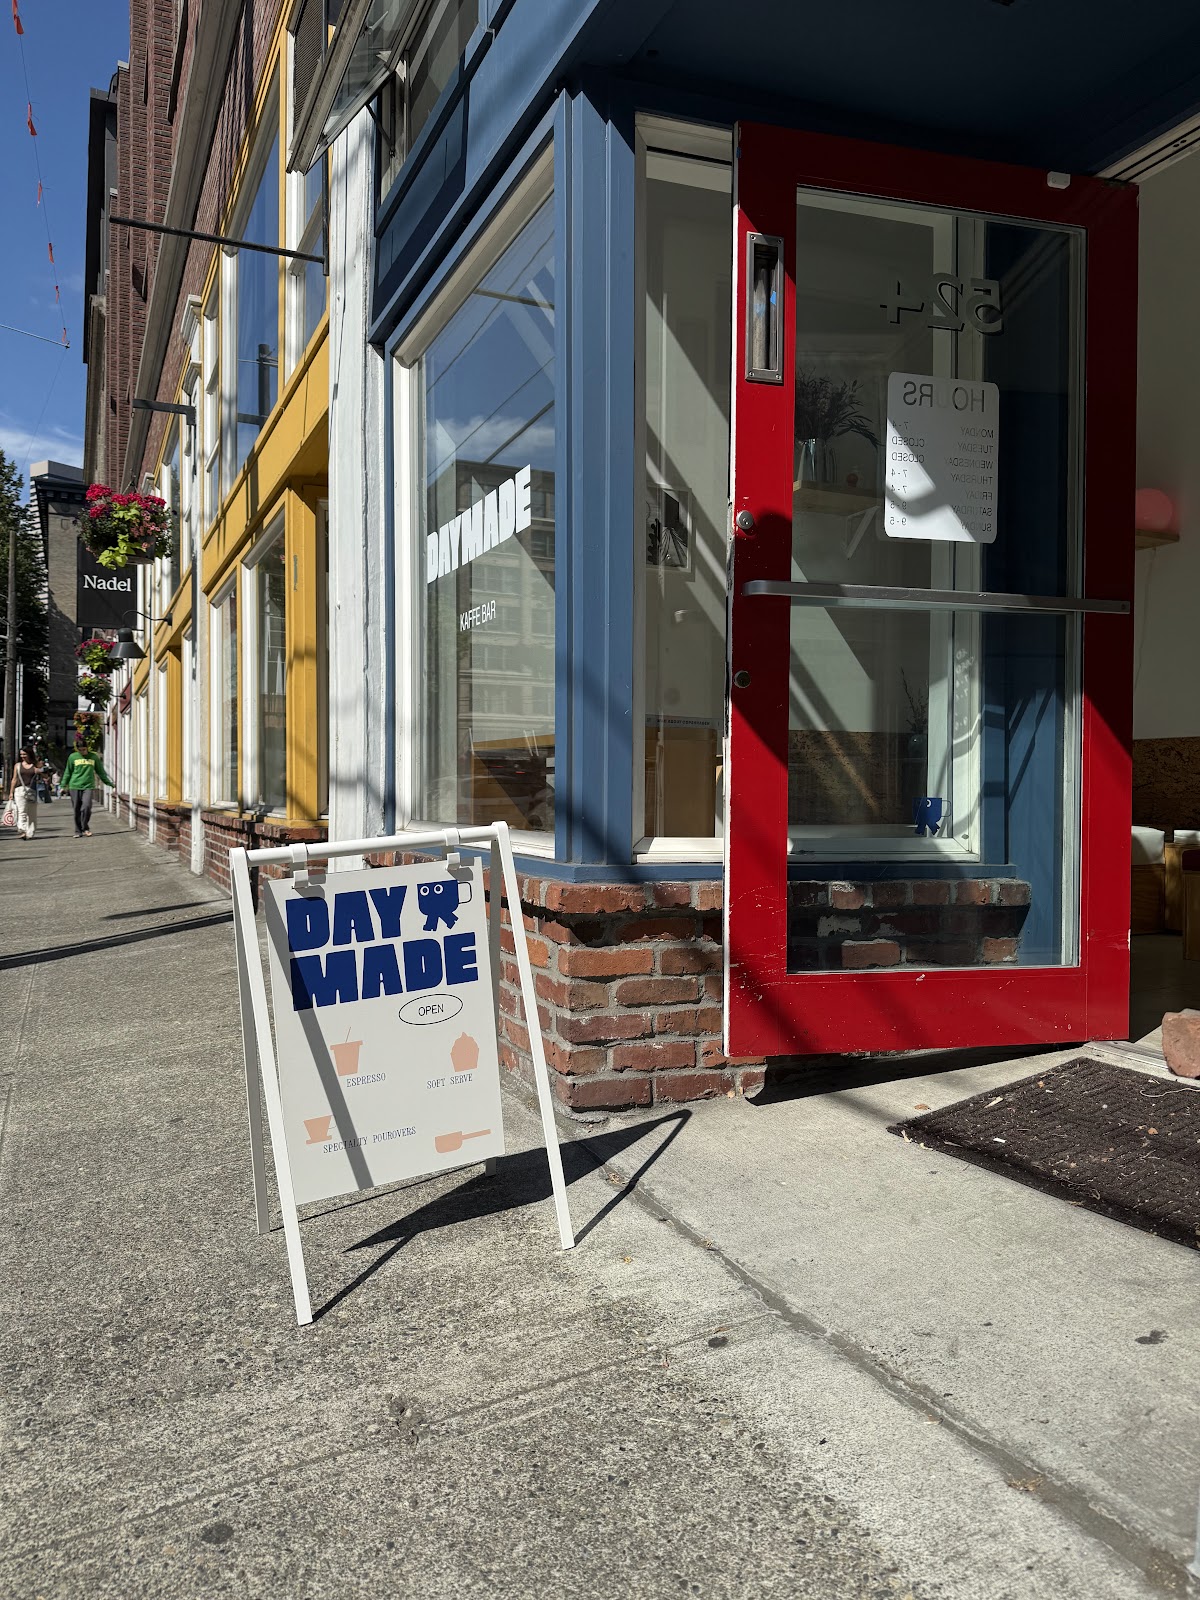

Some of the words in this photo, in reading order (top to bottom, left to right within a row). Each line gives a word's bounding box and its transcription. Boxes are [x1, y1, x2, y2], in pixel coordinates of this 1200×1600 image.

[427, 464, 531, 584] DAYMADE
[83, 574, 132, 592] Nadel
[460, 607, 481, 632] KAFFE
[481, 600, 497, 626] BAR
[285, 885, 408, 952] DAY
[289, 931, 479, 1012] MADE
[418, 1003, 444, 1017] OPEN
[346, 1072, 386, 1087] ESPRESSO
[426, 1078, 446, 1089] SOFT
[450, 1073, 473, 1085] SERVE
[323, 1136, 367, 1154] SPECIALTY
[372, 1126, 417, 1143] POUROVERS
